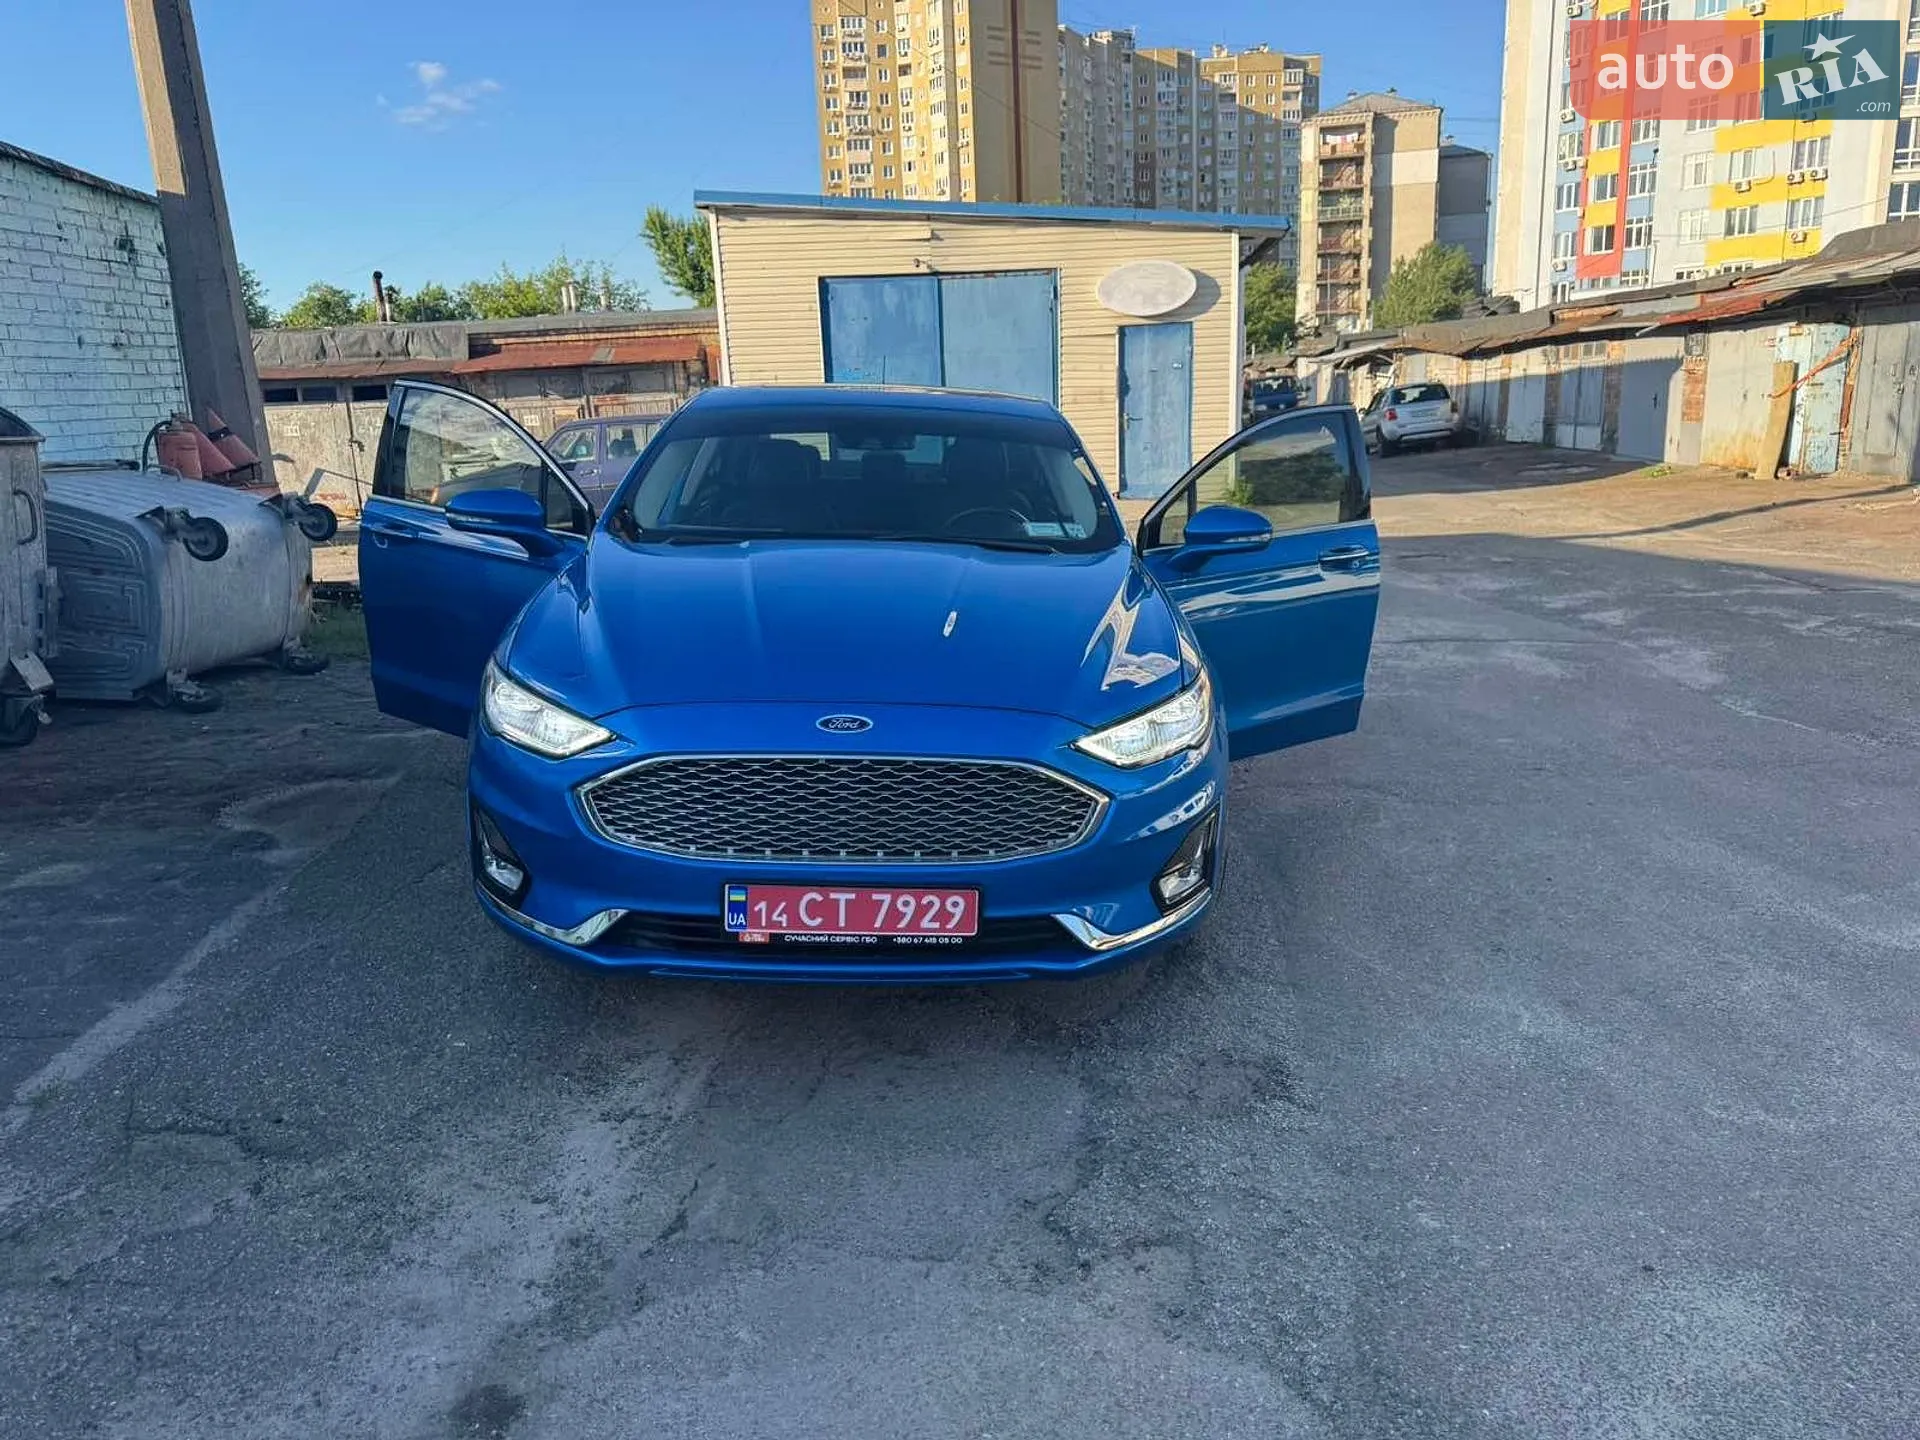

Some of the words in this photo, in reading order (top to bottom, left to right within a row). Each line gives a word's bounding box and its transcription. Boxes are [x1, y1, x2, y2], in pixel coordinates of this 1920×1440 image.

[829, 717, 860, 729] Ford
[754, 901, 788, 927] 14
[799, 892, 856, 927] CT
[871, 893, 966, 929] 7929
[728, 913, 746, 925] UA
